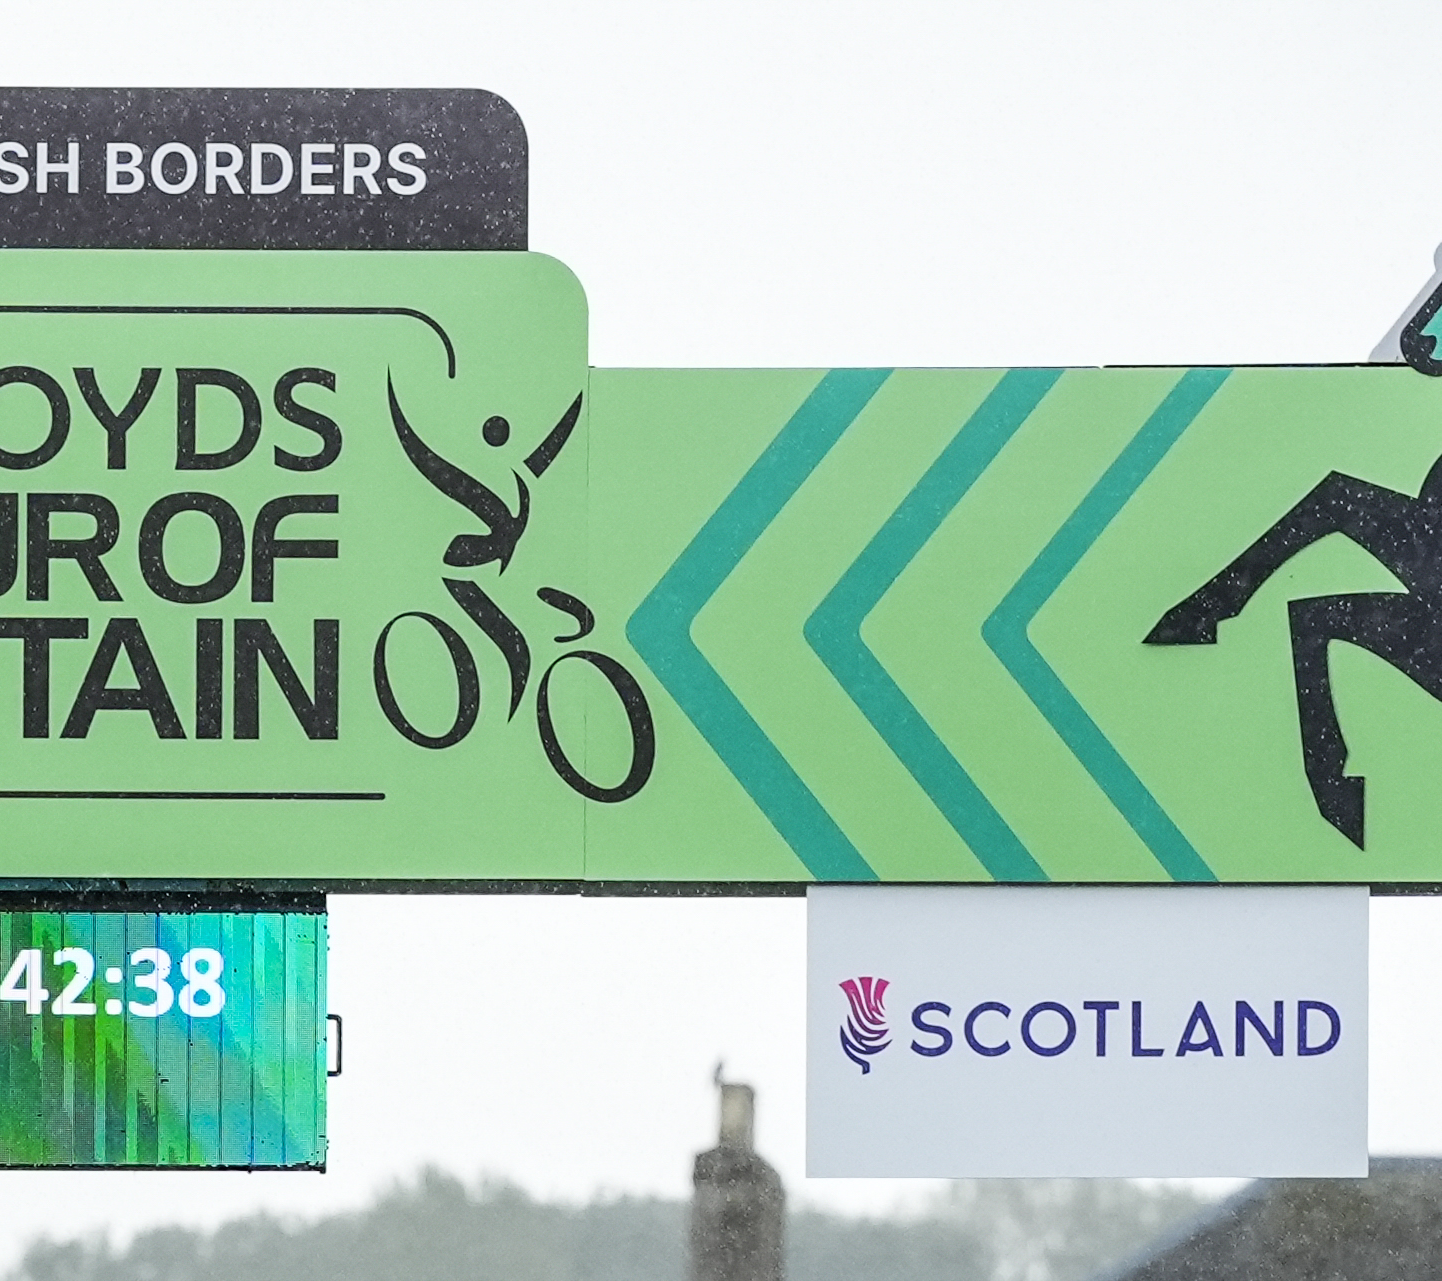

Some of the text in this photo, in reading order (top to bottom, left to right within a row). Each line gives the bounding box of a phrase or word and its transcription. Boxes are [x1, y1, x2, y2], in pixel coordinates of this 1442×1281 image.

[104, 140, 430, 197] BORDERS
[136, 492, 341, 604] OF
[909, 1000, 1343, 1058] SCOTLAND
